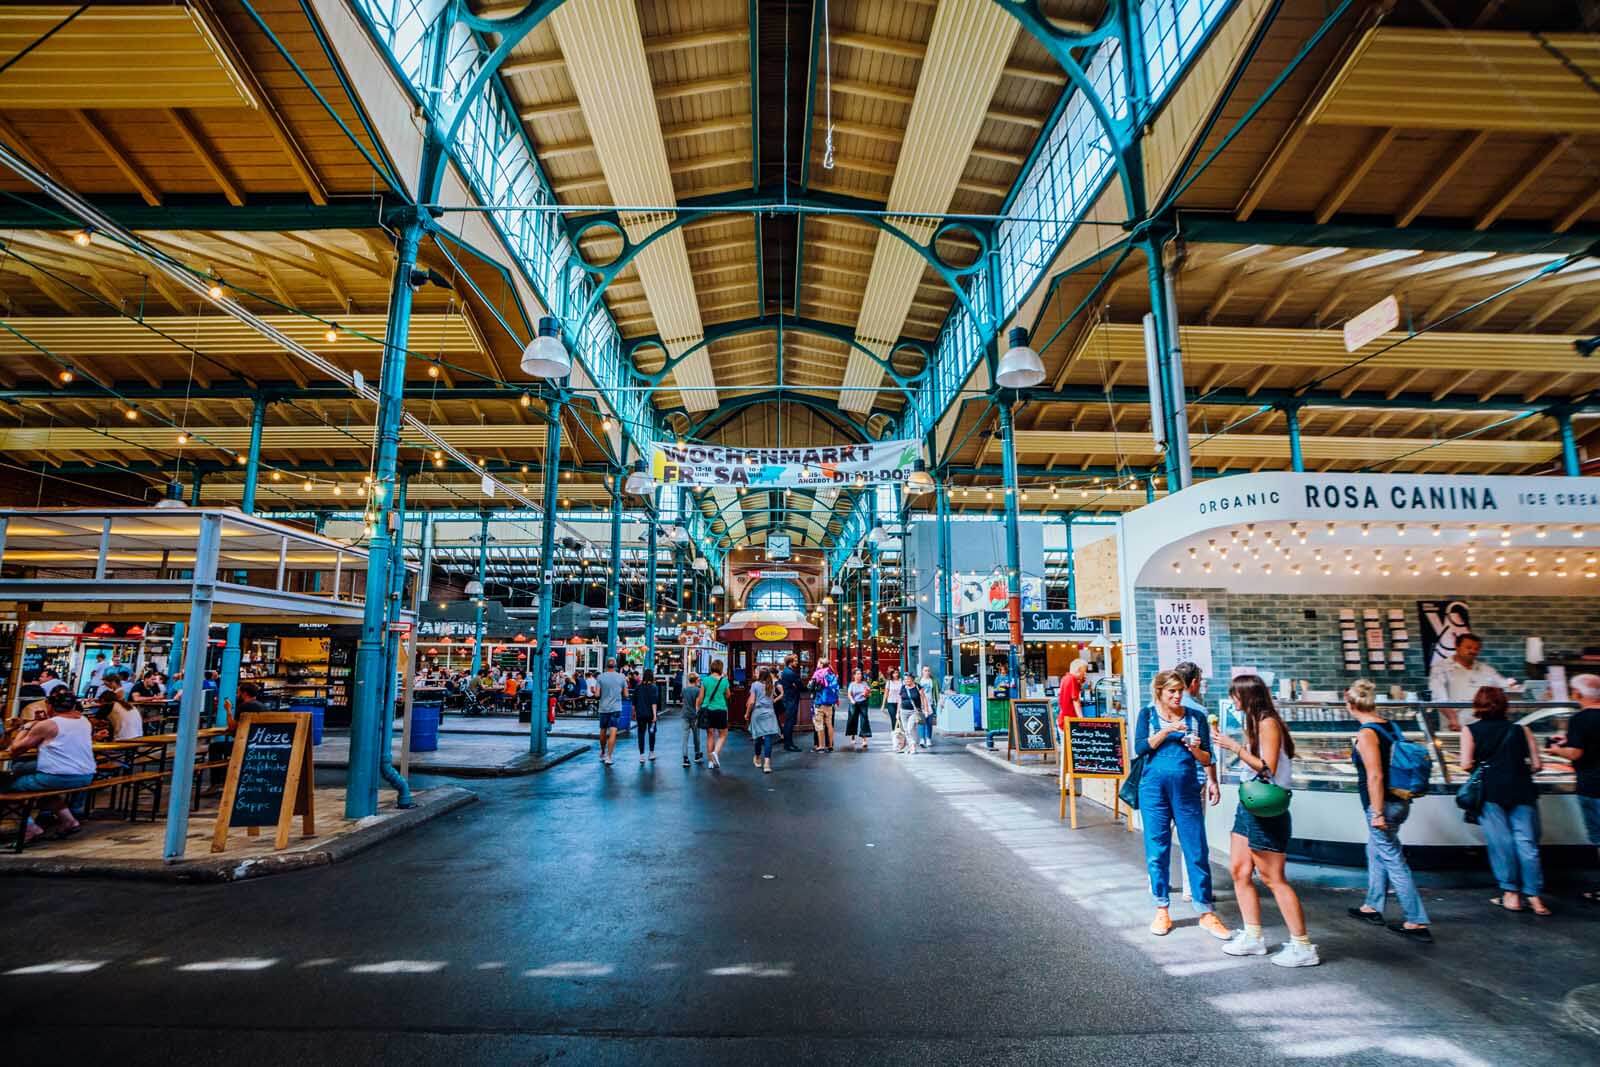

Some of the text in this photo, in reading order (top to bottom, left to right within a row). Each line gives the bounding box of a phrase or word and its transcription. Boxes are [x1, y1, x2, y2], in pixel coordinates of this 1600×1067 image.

[664, 445, 874, 465] WOCHENMARKT
[664, 466, 694, 483] FR
[715, 467, 749, 484] SA
[1200, 491, 1280, 514] ORGANIC
[1305, 484, 1498, 510] ROSA CANINA
[1518, 493, 1547, 506] ICE
[1171, 603, 1191, 613] THE
[1160, 614, 1205, 625] LOVE OF
[1160, 626, 1206, 636] MAKING
[249, 728, 290, 743] Meze
